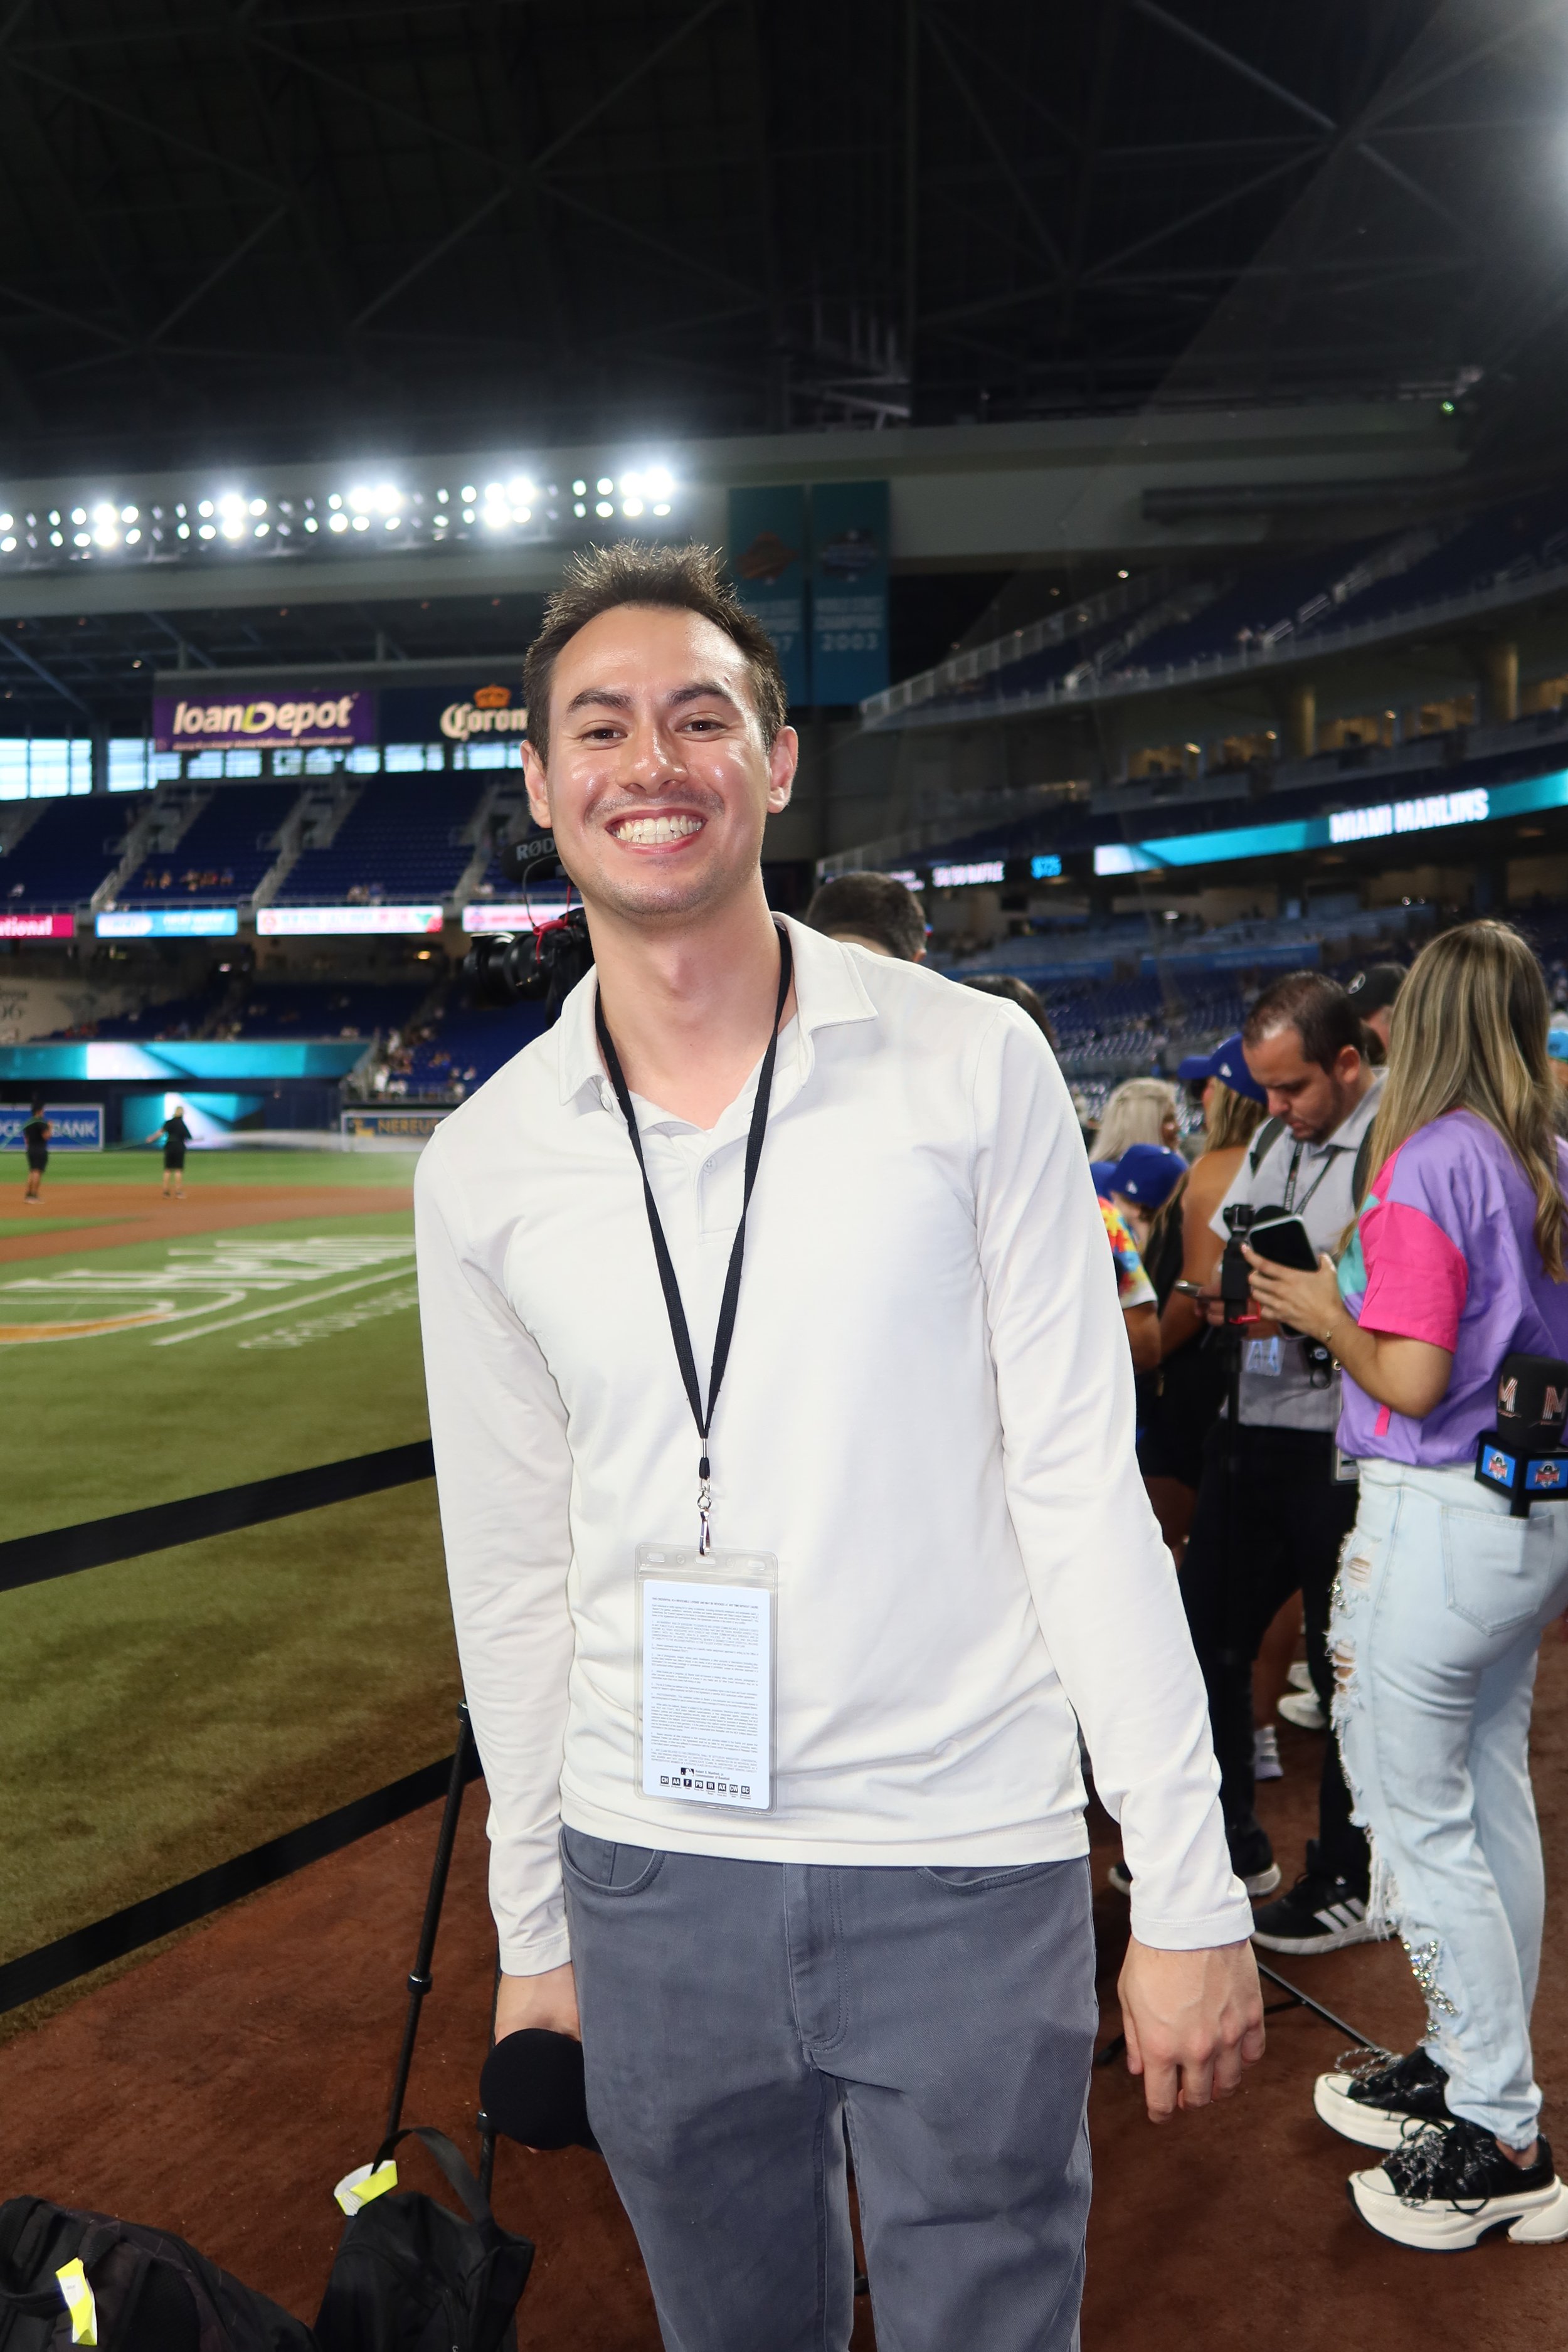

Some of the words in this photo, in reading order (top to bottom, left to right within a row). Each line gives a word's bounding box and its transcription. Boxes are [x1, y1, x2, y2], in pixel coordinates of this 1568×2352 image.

[172, 695, 354, 737] loanDepot
[1329, 803, 1392, 844] MIAMI
[1394, 787, 1489, 833] MARLINS
